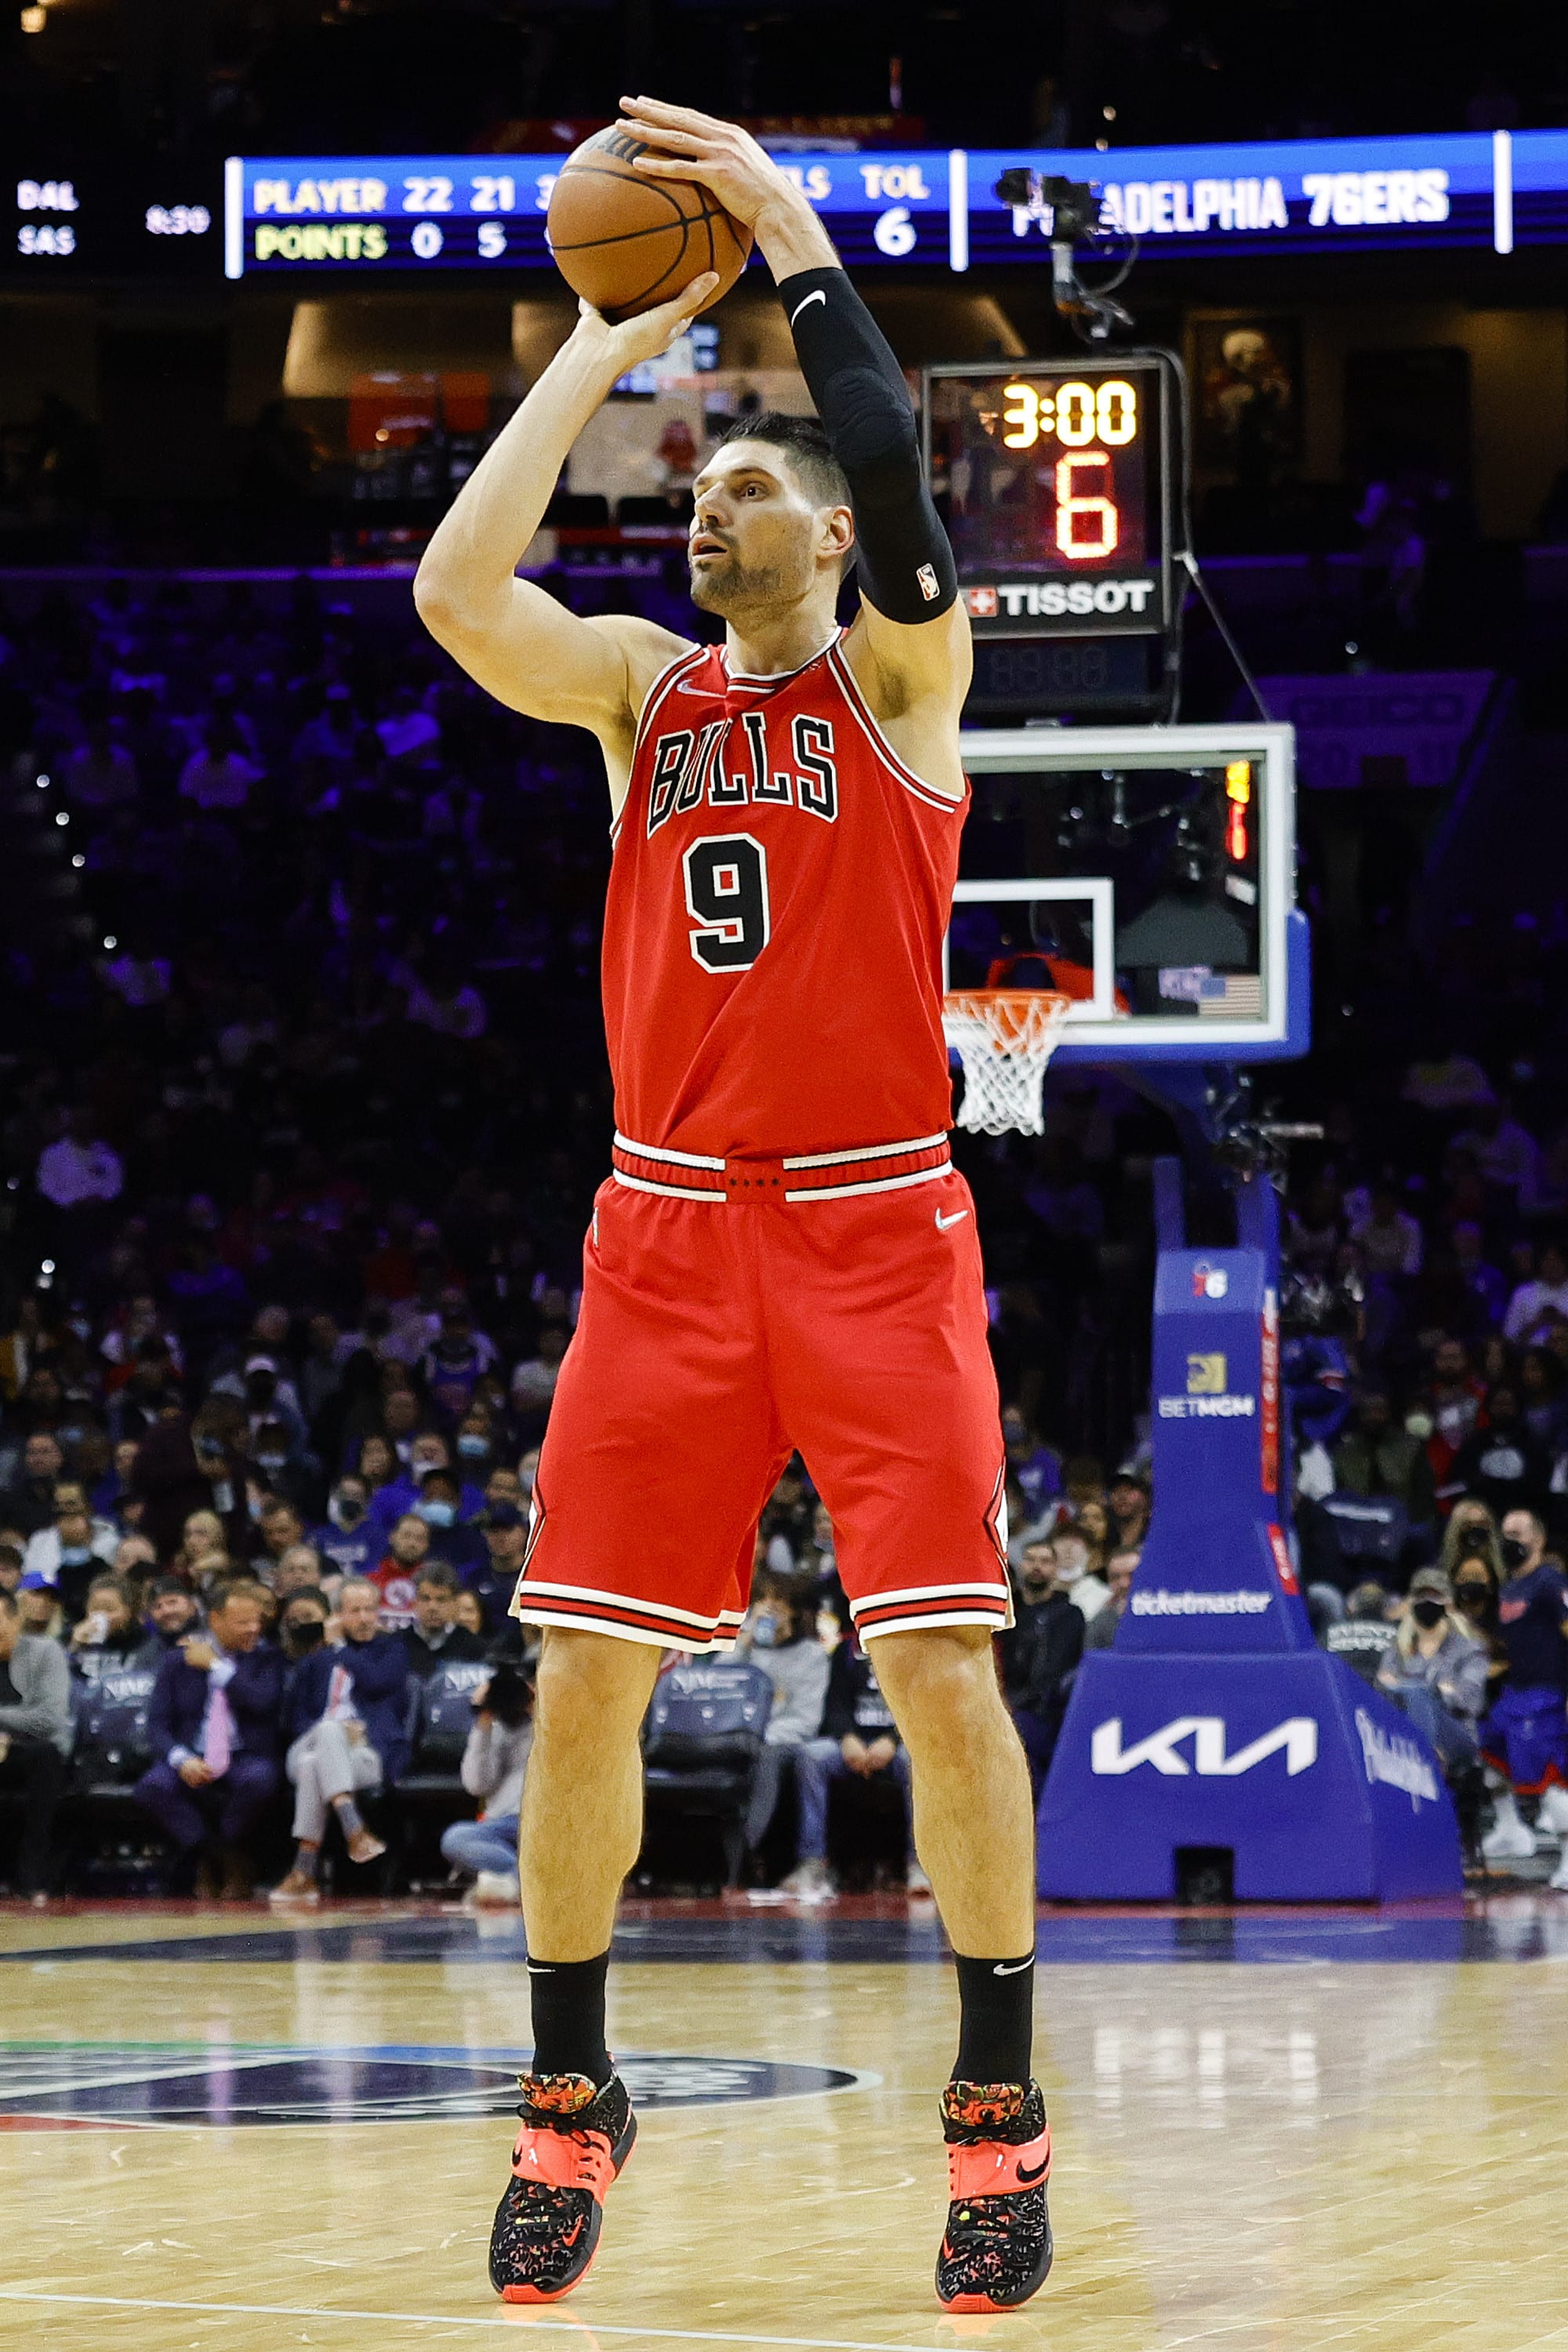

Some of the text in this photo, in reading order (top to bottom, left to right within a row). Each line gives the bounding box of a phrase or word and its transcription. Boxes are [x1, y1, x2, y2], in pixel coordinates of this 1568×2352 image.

[253, 179, 388, 213] PLAYER
[402, 176, 453, 212] 22
[470, 176, 515, 212] 21
[859, 164, 931, 200] TOL
[1302, 168, 1449, 226] 76ERS
[17, 224, 77, 255] SAS
[253, 222, 506, 260] POINTS 0 5
[873, 206, 917, 256] 6
[1003, 380, 1137, 449] 3:00
[1055, 450, 1119, 560] 6
[998, 579, 1156, 616] TISSOT
[646, 710, 839, 840] BULLS
[681, 832, 771, 975] 9
[1158, 1395, 1255, 1418] BETMGM
[1131, 1588, 1272, 1617] ticketmaster
[1091, 1715, 1318, 1777] KIA
